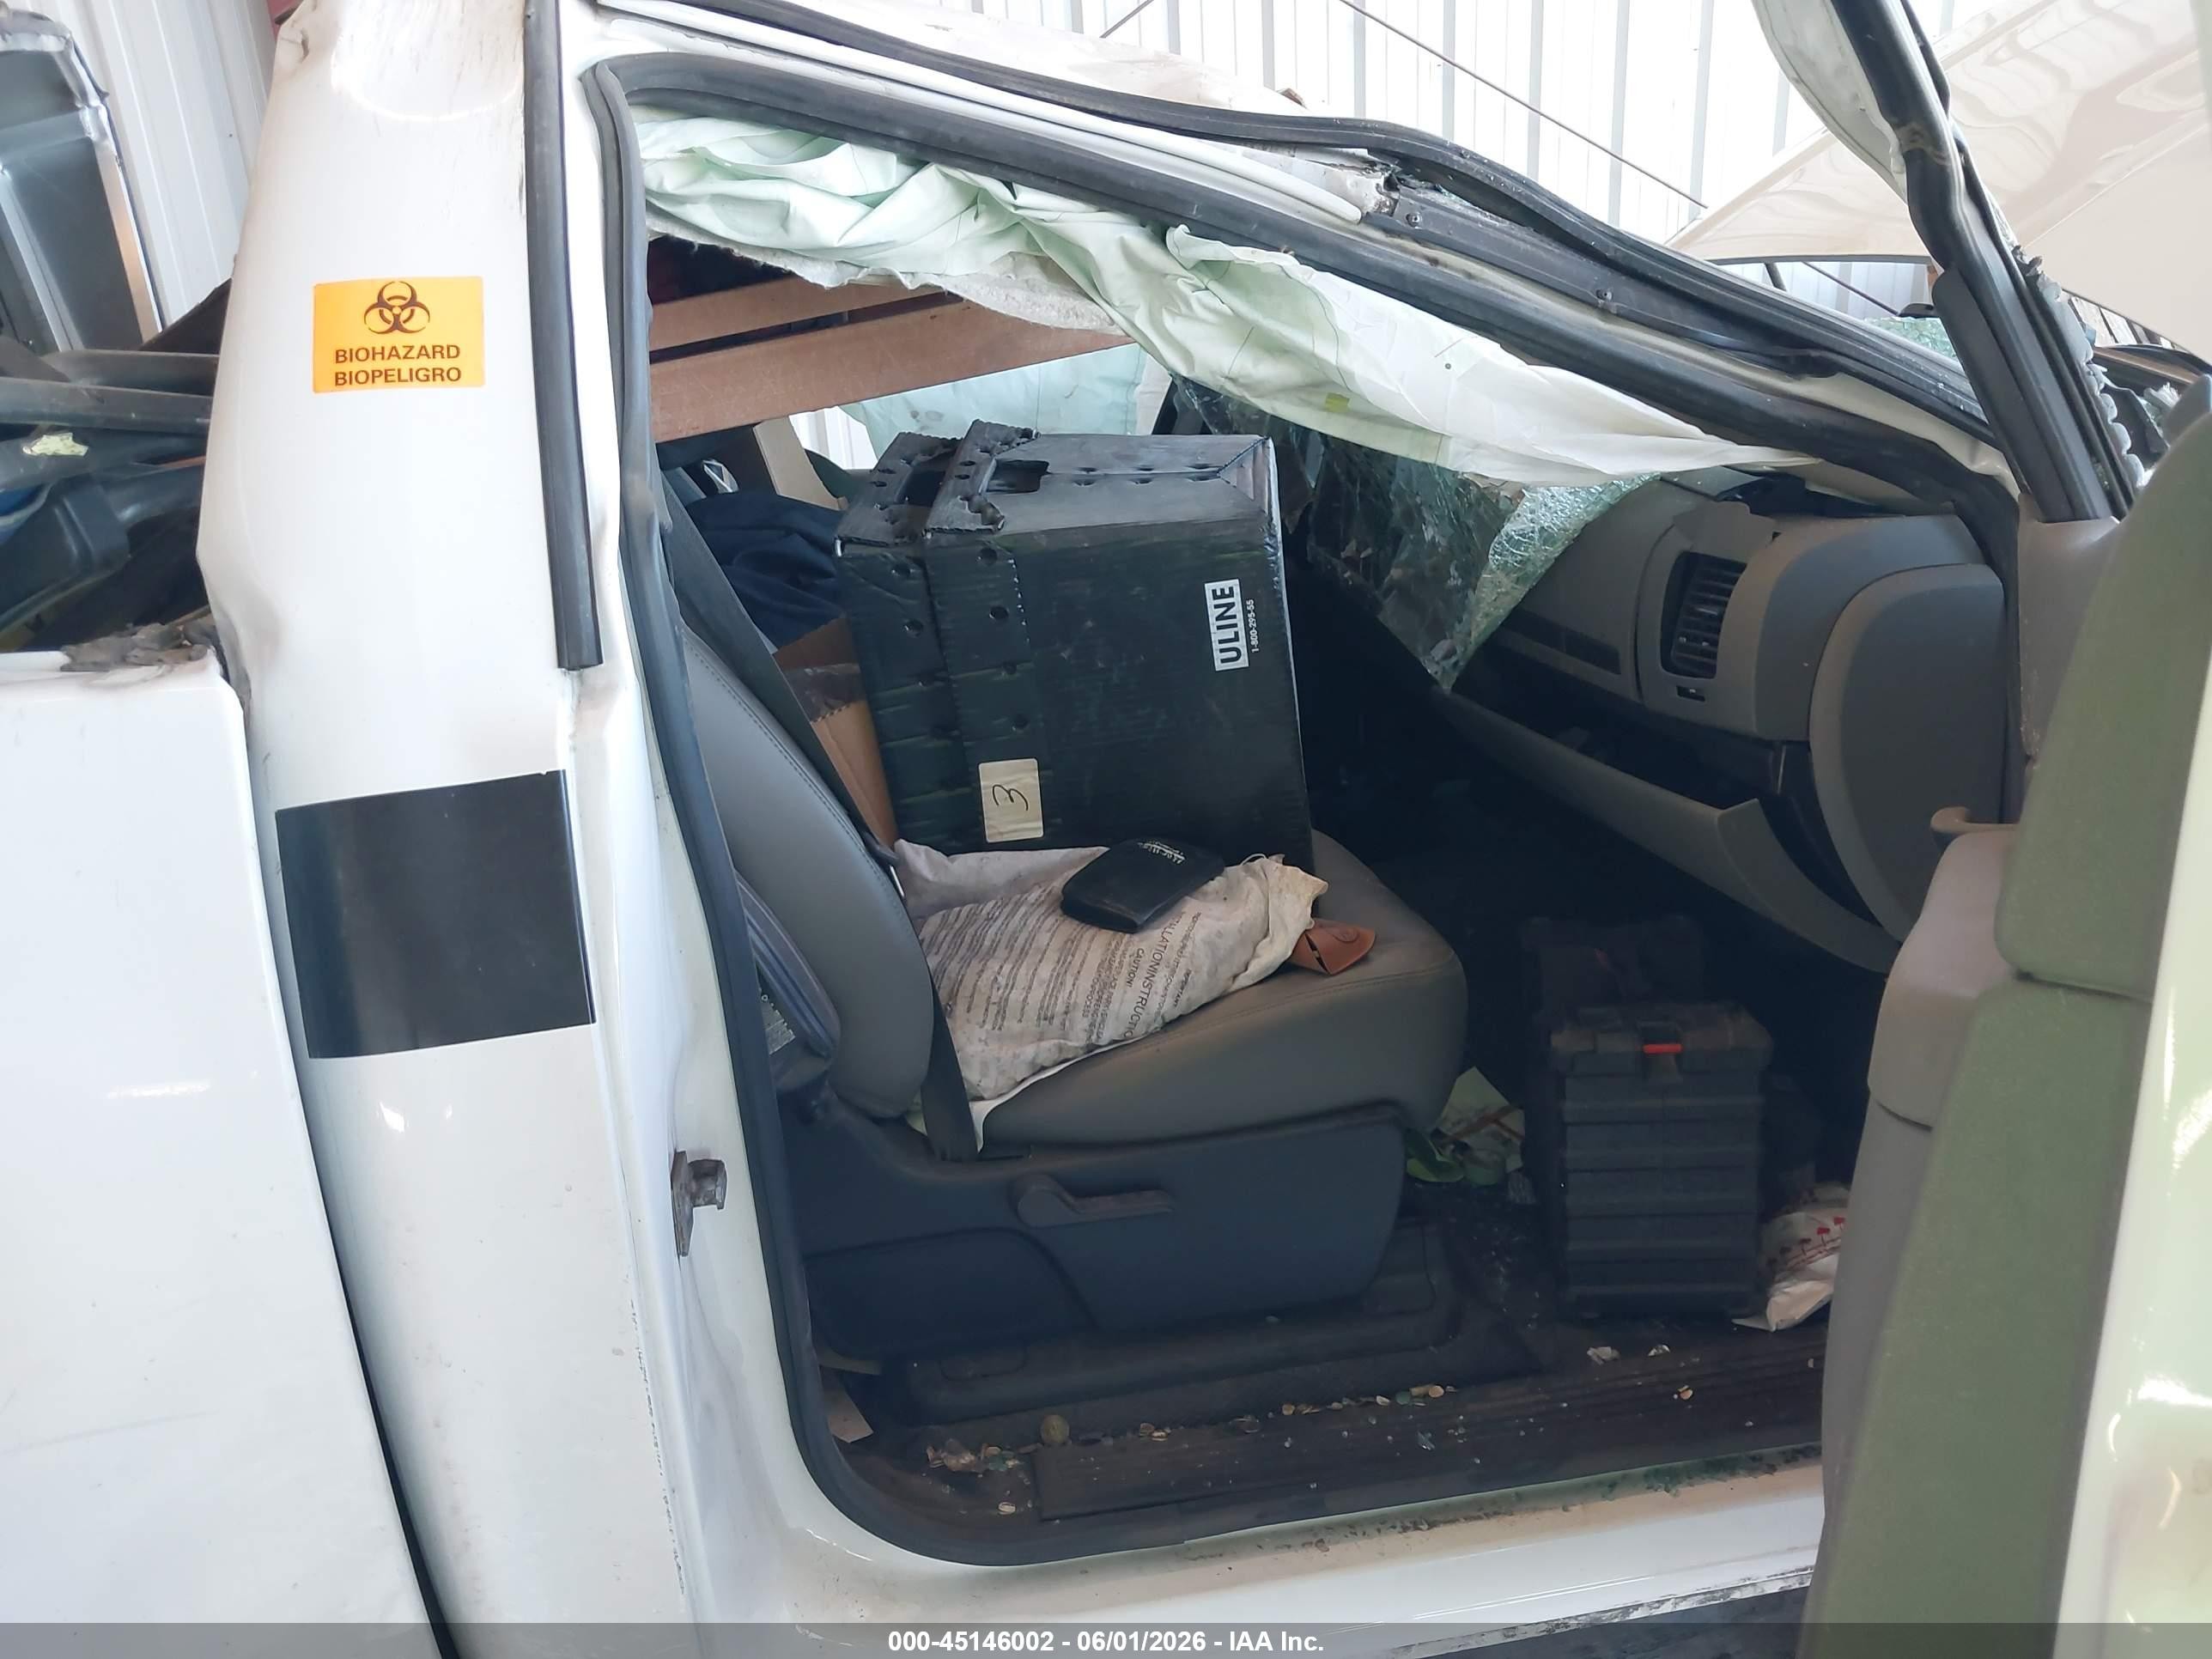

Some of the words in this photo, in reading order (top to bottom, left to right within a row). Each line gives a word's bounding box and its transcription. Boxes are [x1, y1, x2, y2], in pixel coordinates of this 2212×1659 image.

[335, 343, 461, 364] BIOHAZARD
[335, 367, 462, 386] BIOPELIGRO
[1212, 586, 1242, 664] ULINE
[1126, 947, 1145, 988] CAUTION!
